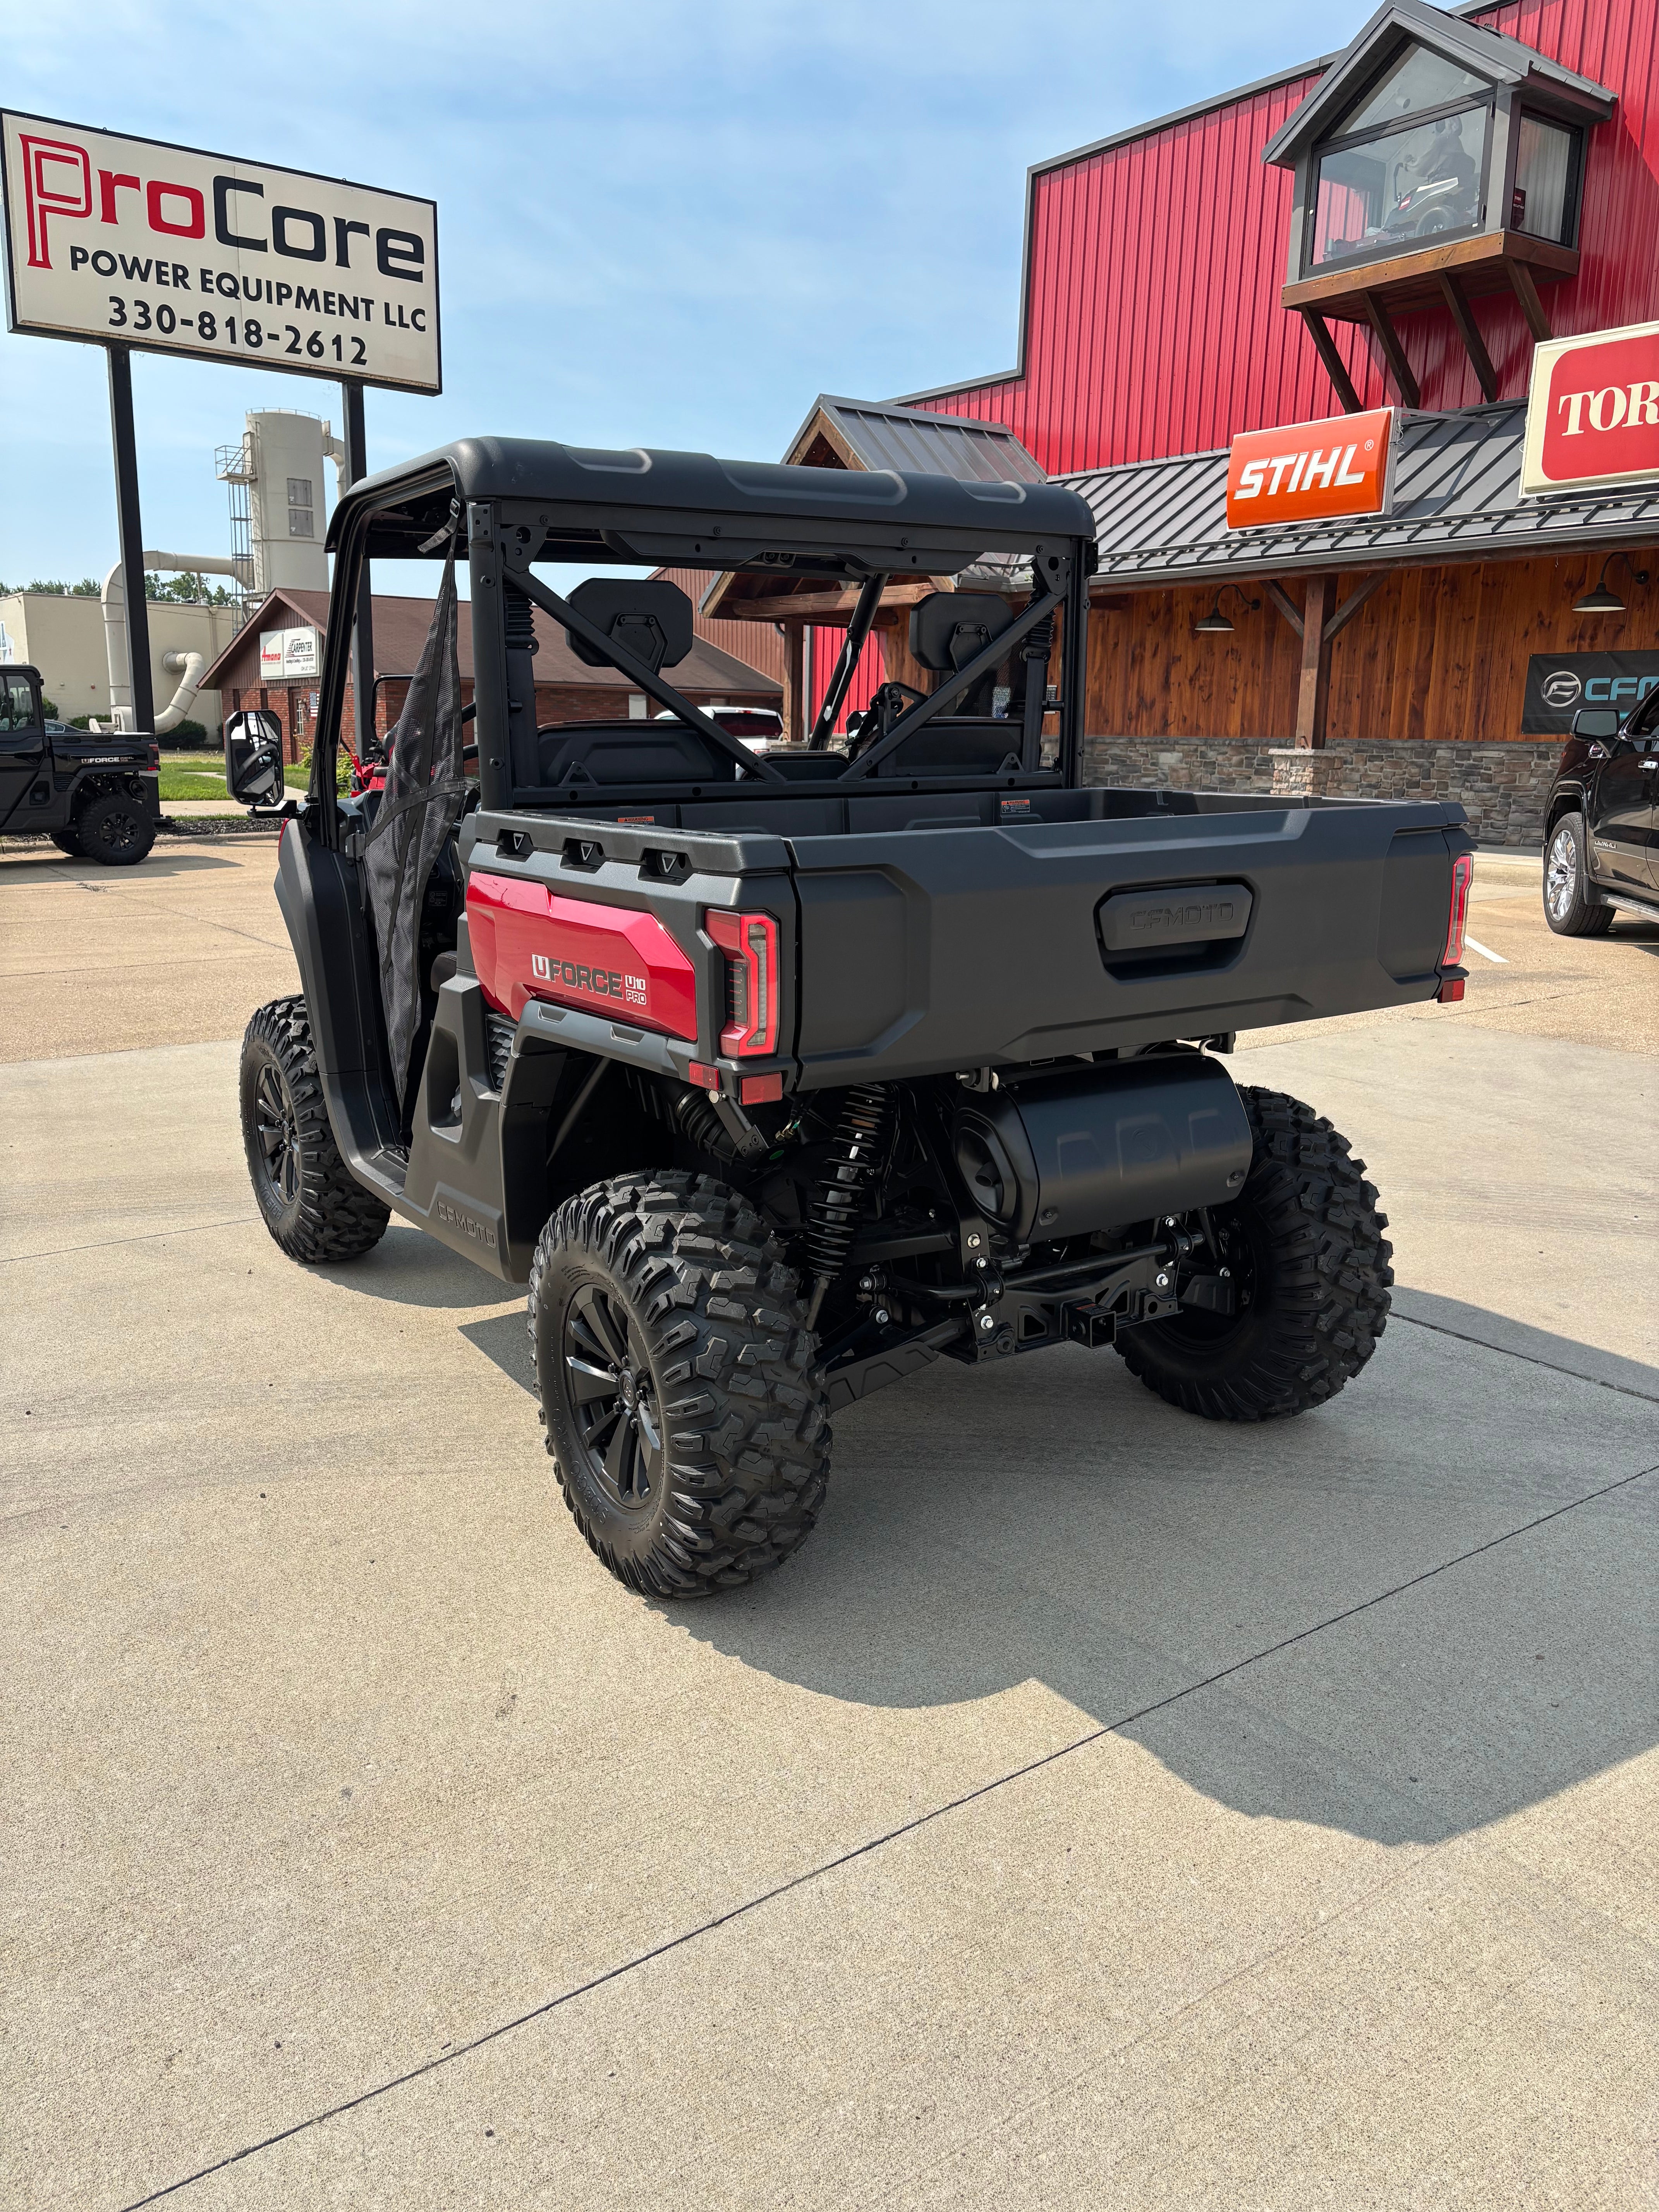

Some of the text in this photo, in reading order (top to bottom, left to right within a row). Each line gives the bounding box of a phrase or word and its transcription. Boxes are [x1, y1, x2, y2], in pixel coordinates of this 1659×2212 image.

[18, 133, 424, 282] ProCore
[70, 246, 426, 332] POWER EQUIPMENT LLC
[109, 296, 368, 366] 330-818-2612
[1233, 444, 1365, 500] STIHL
[262, 646, 281, 661] Amana
[292, 641, 313, 653] CARPENTER
[1130, 903, 1233, 930] CFMOTO
[532, 954, 646, 1000] UFORCE U10
[626, 990, 647, 1005] PRO
[437, 1200, 496, 1249] CFMOTO
